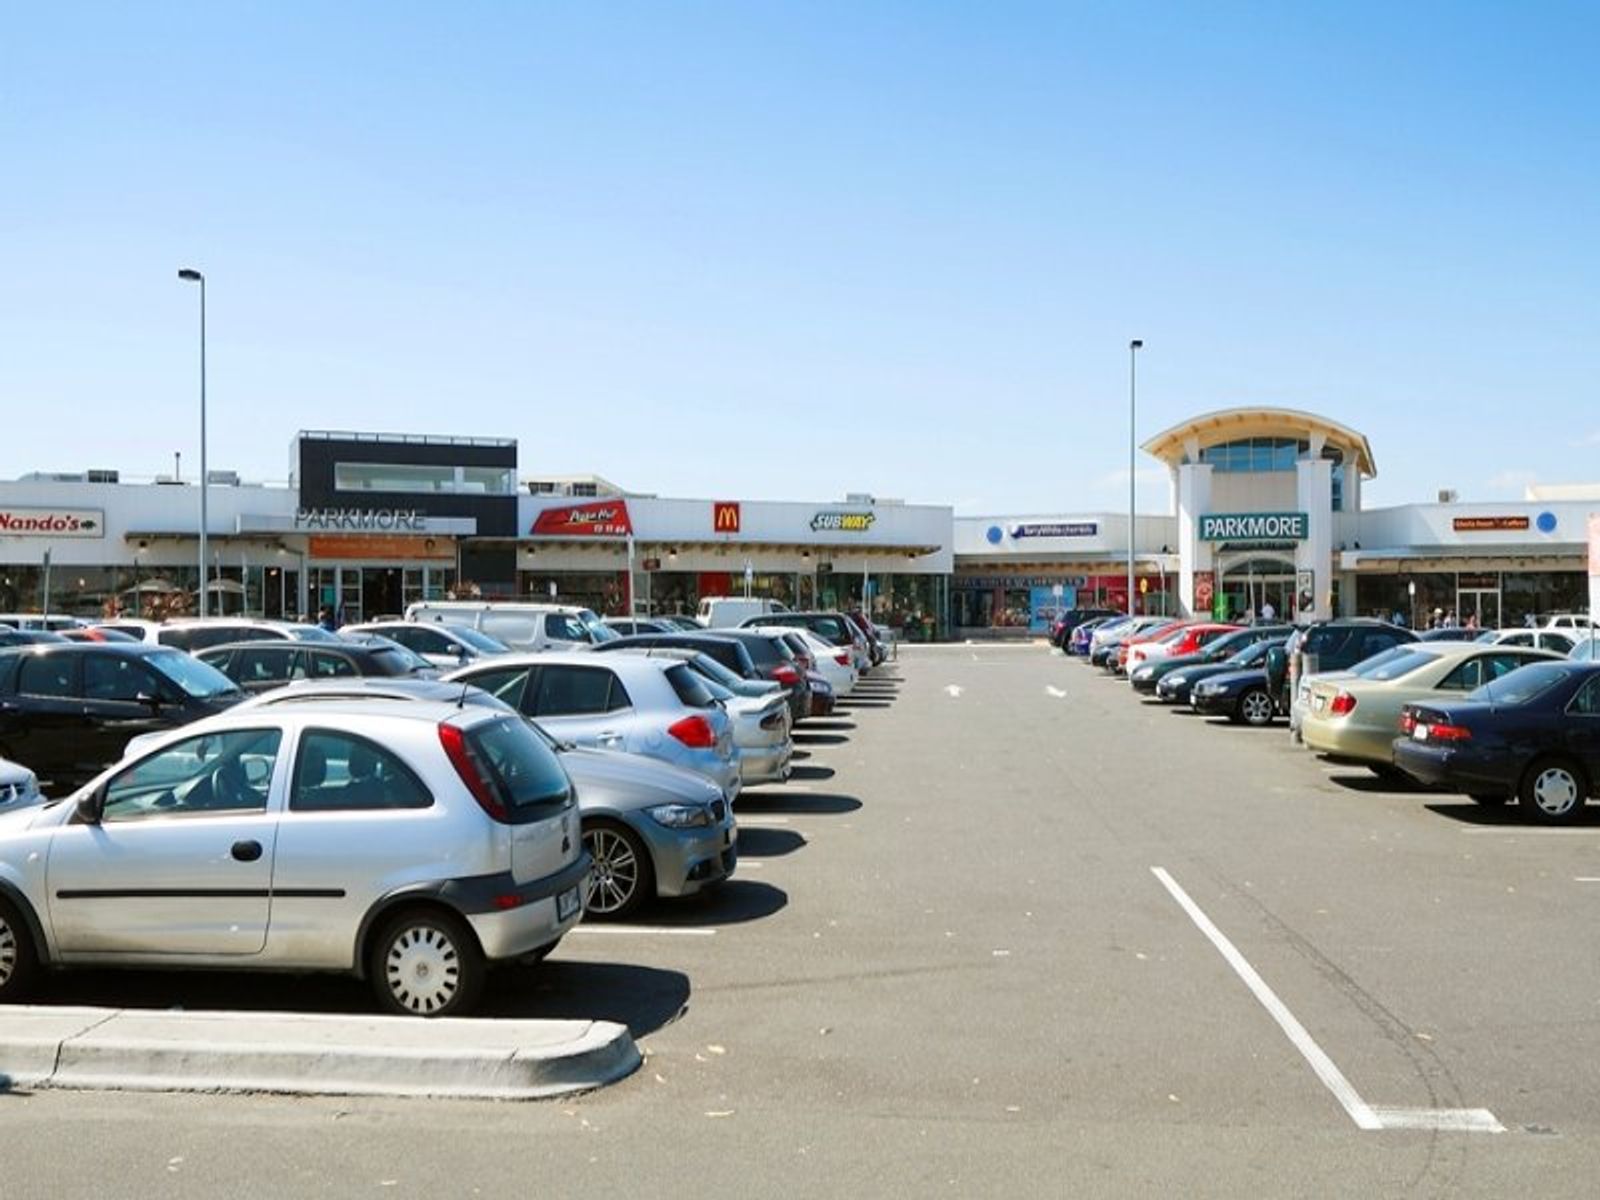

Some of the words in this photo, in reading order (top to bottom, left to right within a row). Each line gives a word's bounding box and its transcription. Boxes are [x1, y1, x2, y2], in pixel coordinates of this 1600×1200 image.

[0, 513, 79, 531] Nando's
[294, 508, 426, 530] PARKMORE
[813, 512, 874, 531] SUBWAY
[1204, 517, 1301, 537] PARKMORE
